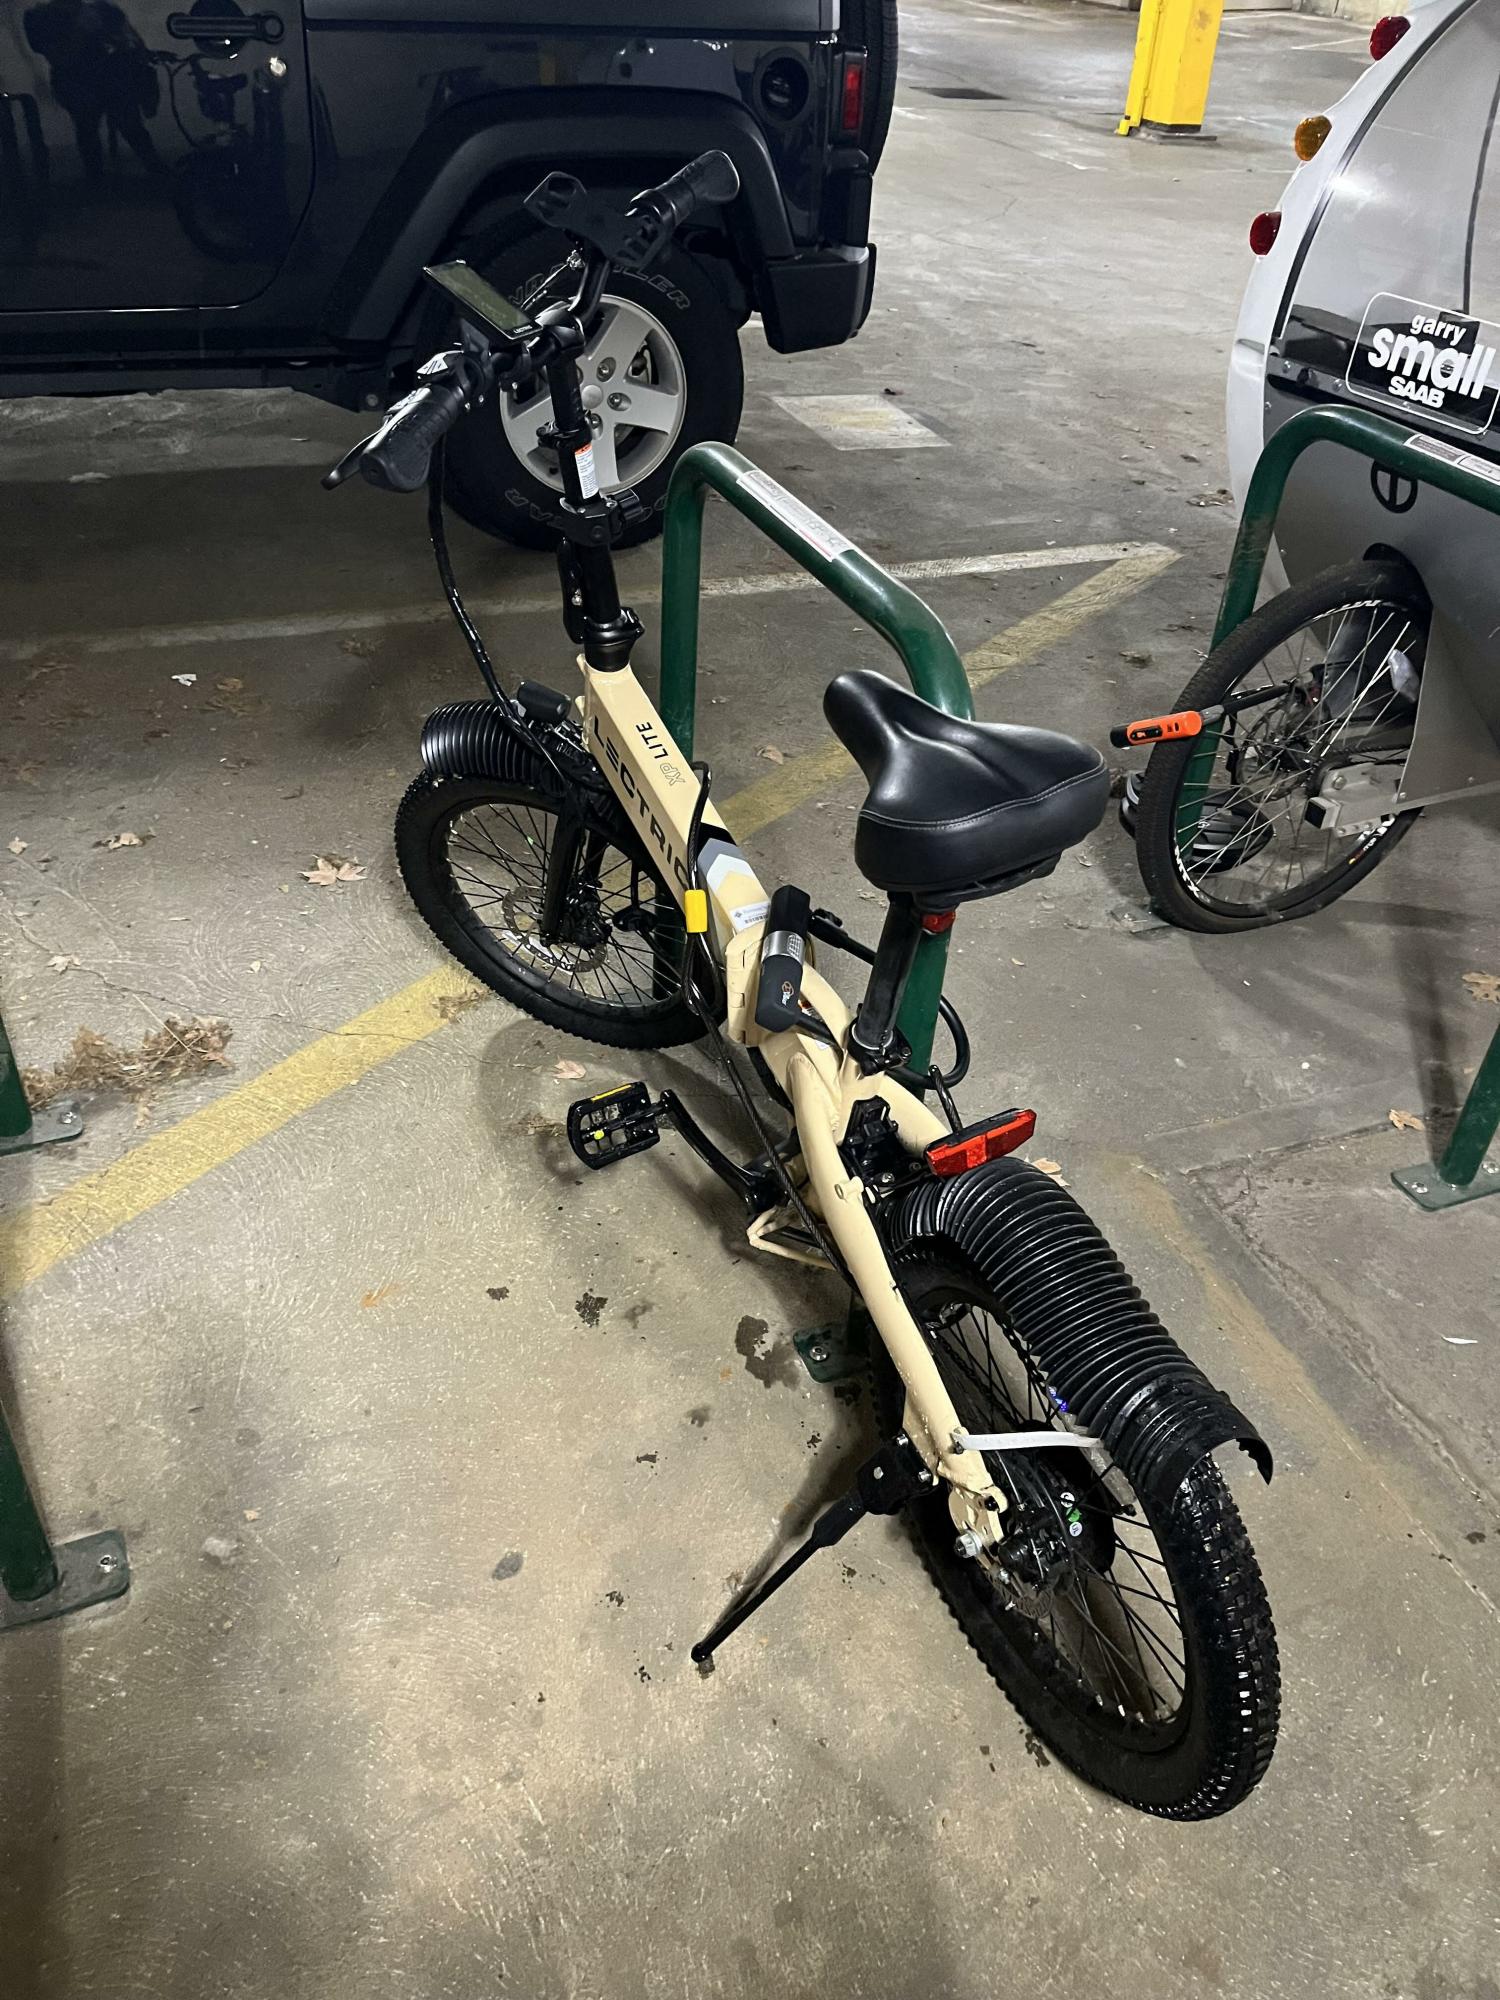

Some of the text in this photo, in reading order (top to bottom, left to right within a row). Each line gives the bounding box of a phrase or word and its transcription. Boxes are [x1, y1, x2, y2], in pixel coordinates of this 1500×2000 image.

[1410, 314, 1467, 344] garry
[1367, 327, 1497, 400] small
[1388, 375, 1445, 409] SAAB
[636, 721, 685, 786] XP LITE
[594, 715, 690, 887] LECTRIC
